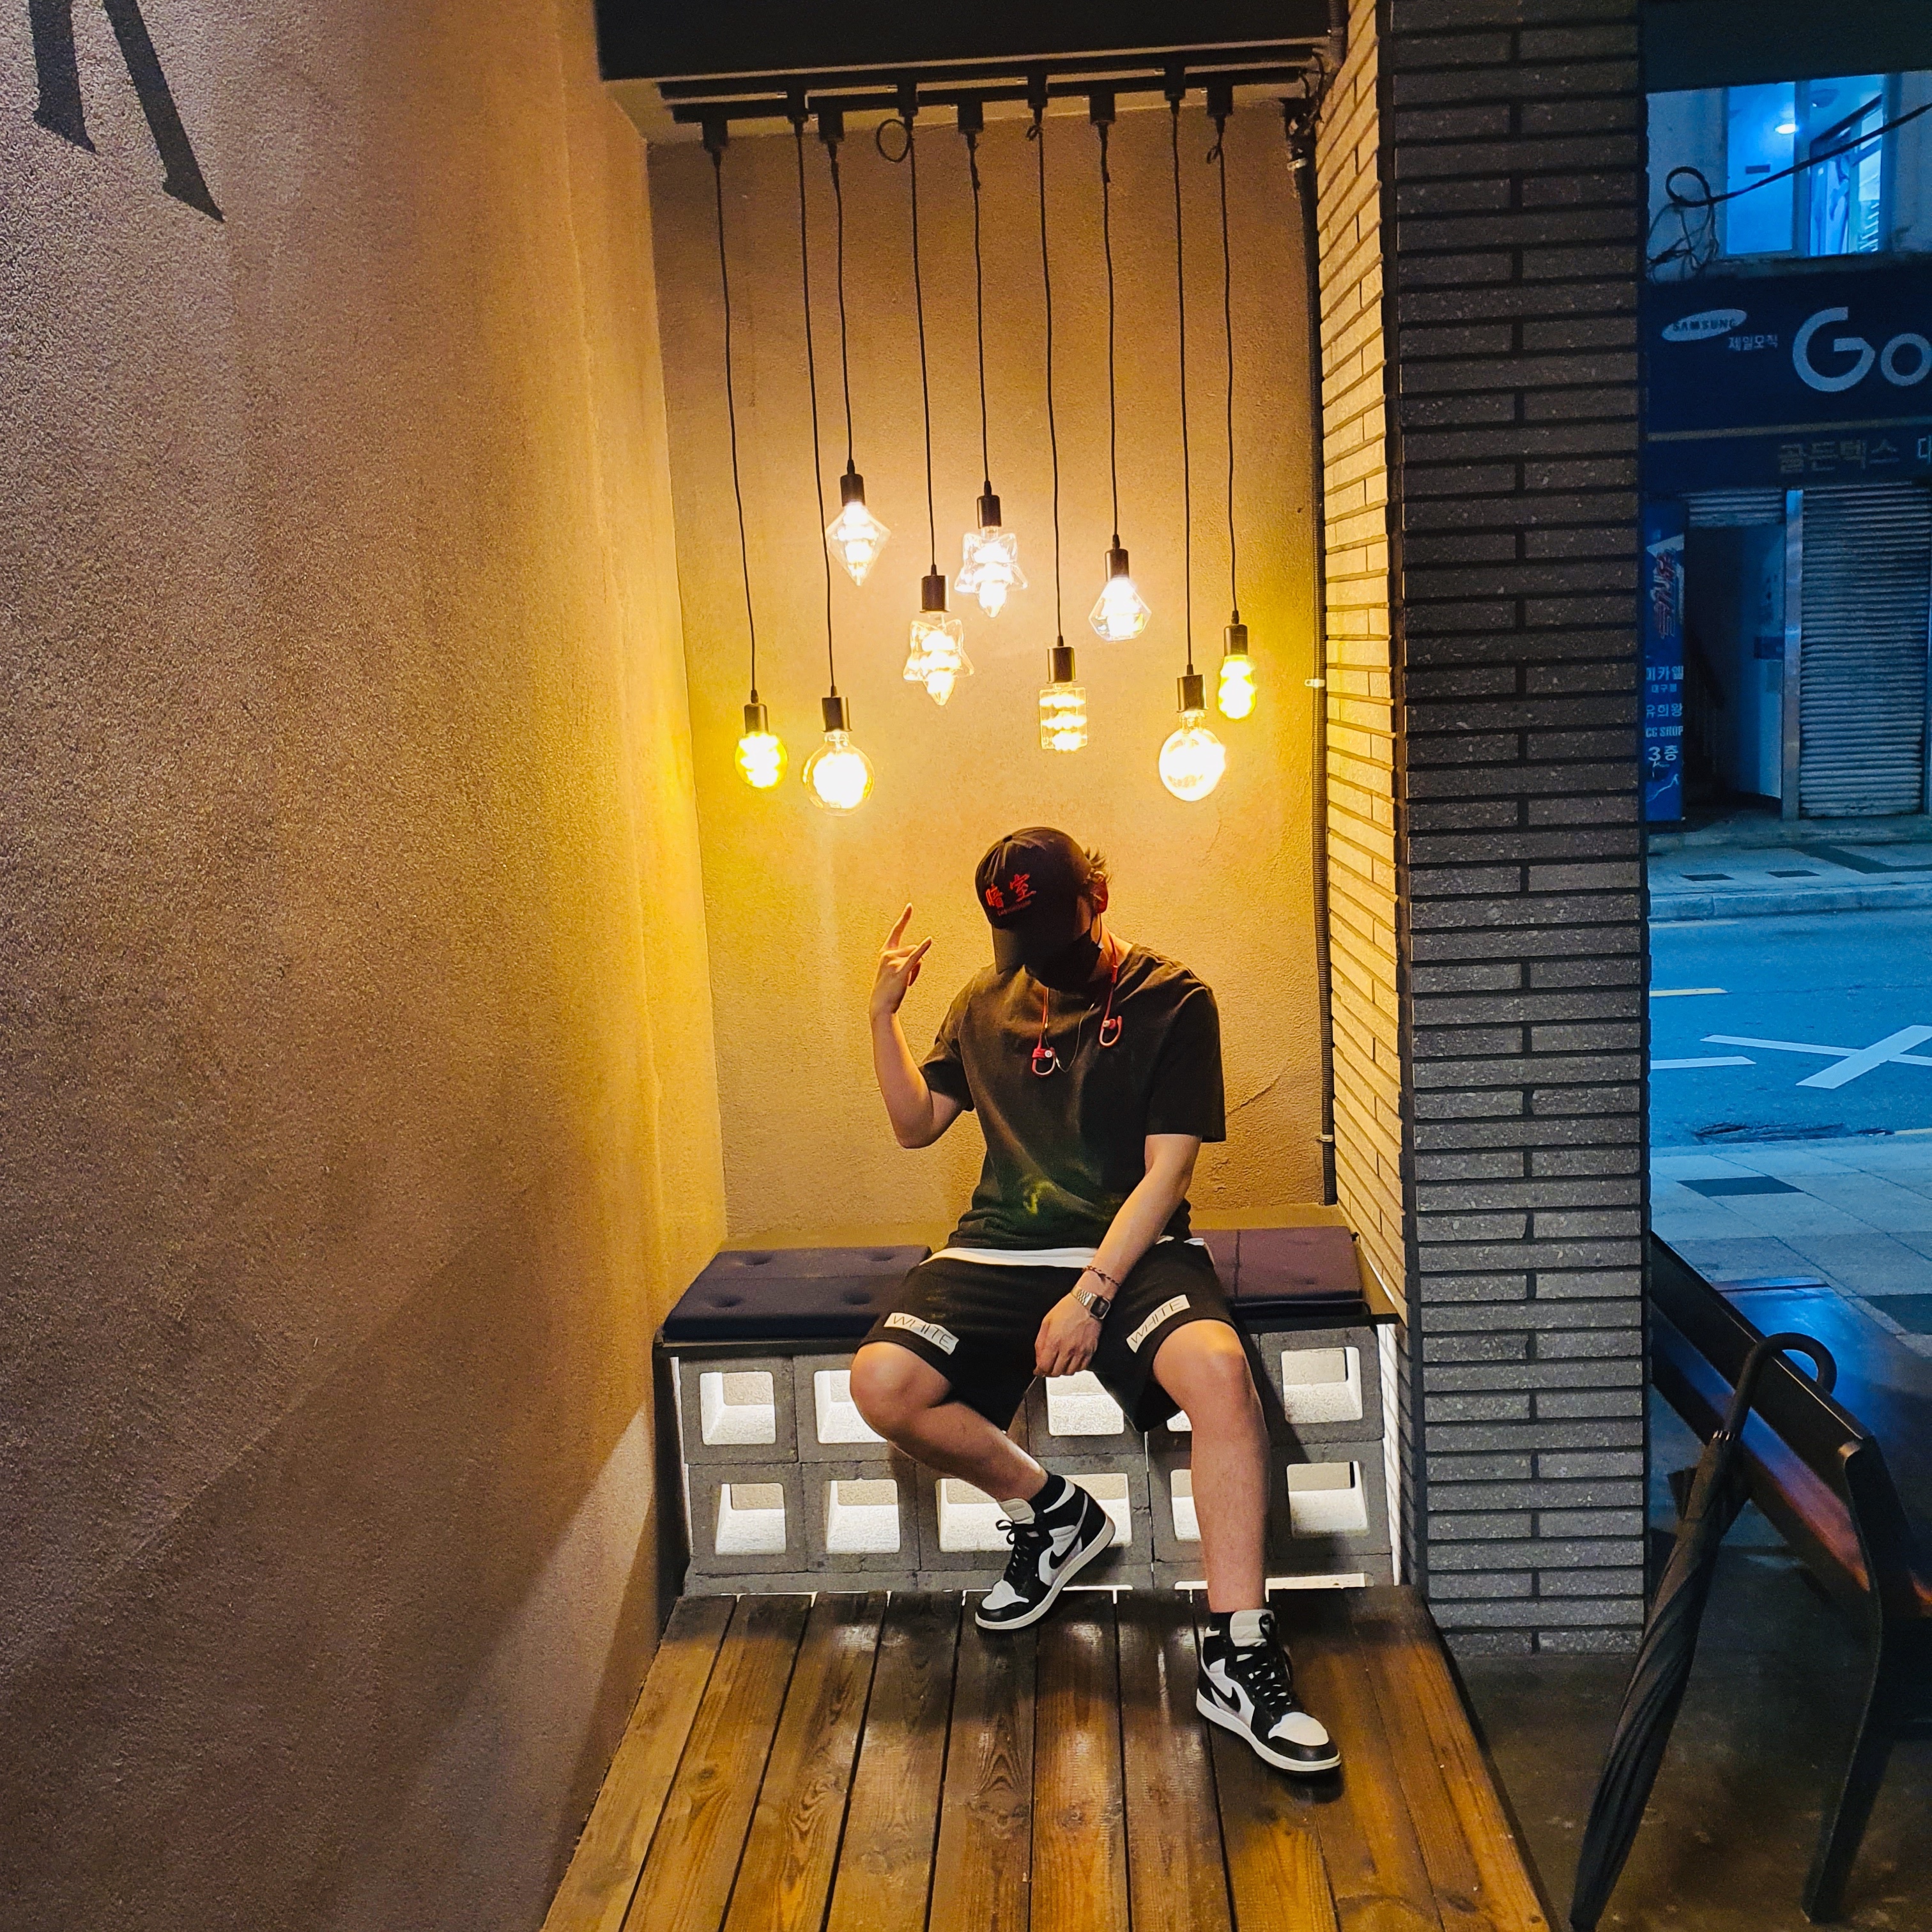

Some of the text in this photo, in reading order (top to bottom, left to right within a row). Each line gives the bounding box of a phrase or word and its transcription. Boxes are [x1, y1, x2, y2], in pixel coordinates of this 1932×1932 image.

[1673, 318, 1736, 331] SAMSUNG
[1646, 703, 1683, 719] 유희왕
[1659, 726, 1684, 737] SHOP
[1131, 1298, 1184, 1344] WHITE
[893, 1315, 953, 1350] WHITE
